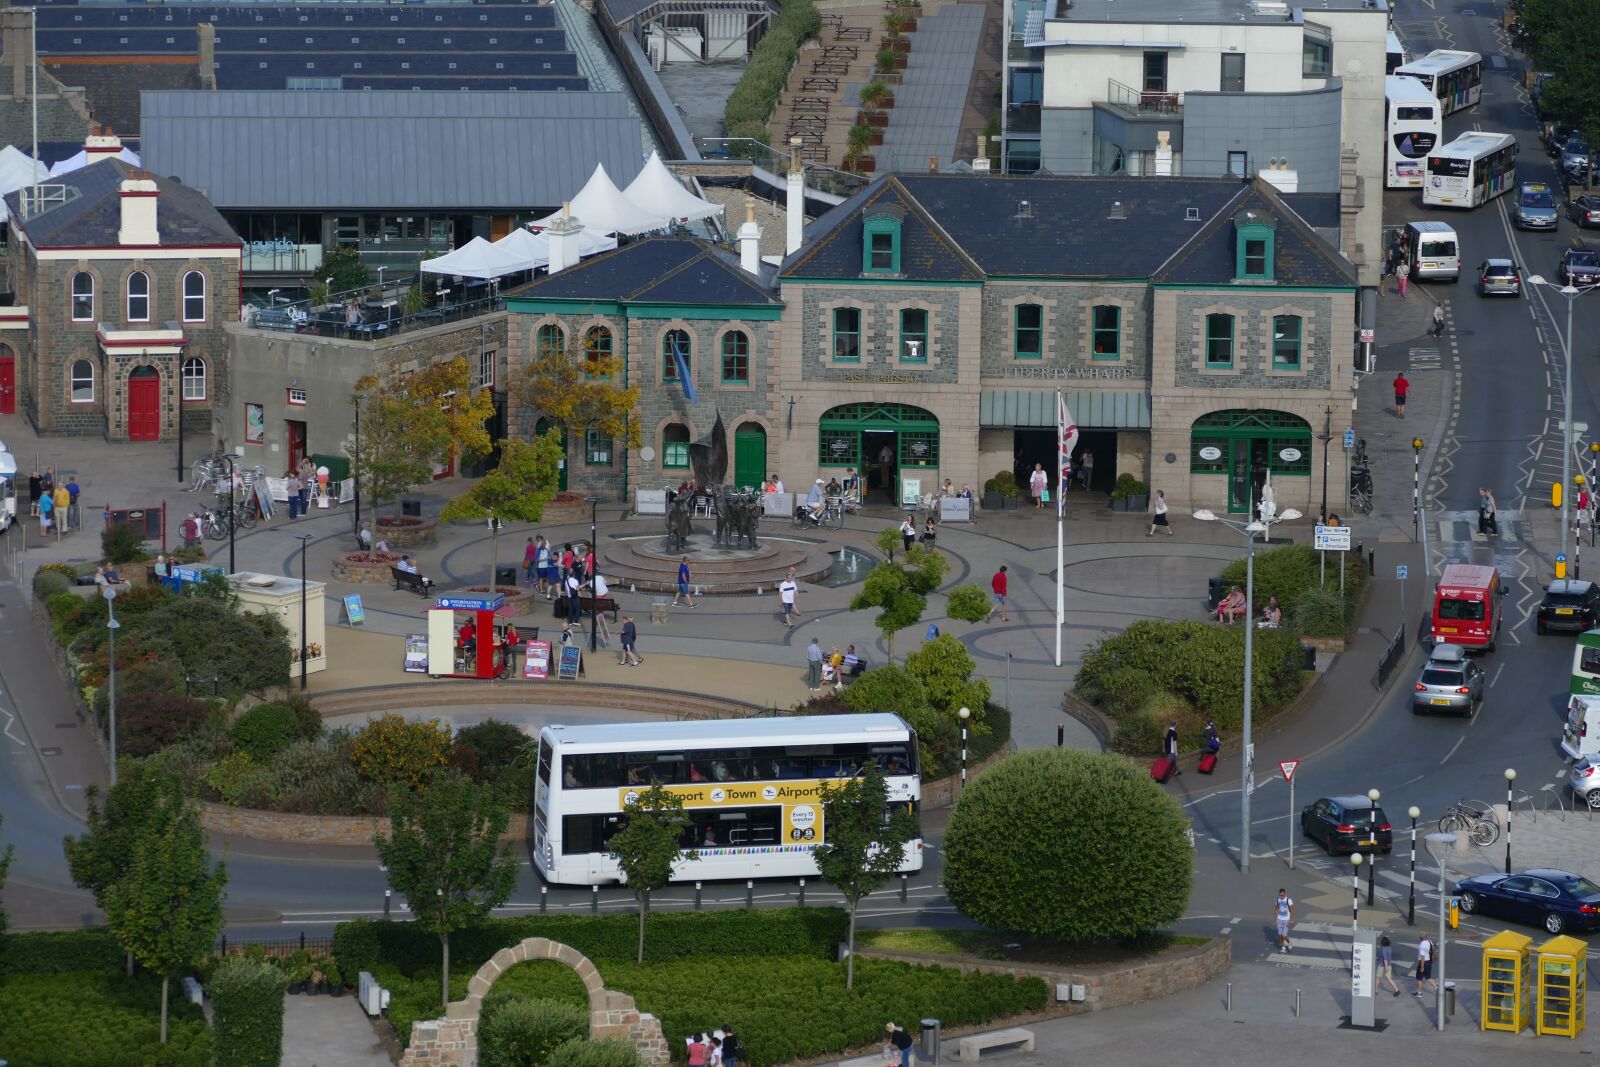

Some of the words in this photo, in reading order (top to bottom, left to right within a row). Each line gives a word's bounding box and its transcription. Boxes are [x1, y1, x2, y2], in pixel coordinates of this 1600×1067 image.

[843, 373, 871, 383] PASTY
[878, 373, 917, 384] PRESTO
[1004, 367, 1071, 380] LIBERTY
[1074, 368, 1133, 380] WHARF
[726, 789, 757, 799] Town
[777, 787, 820, 799] Airport
